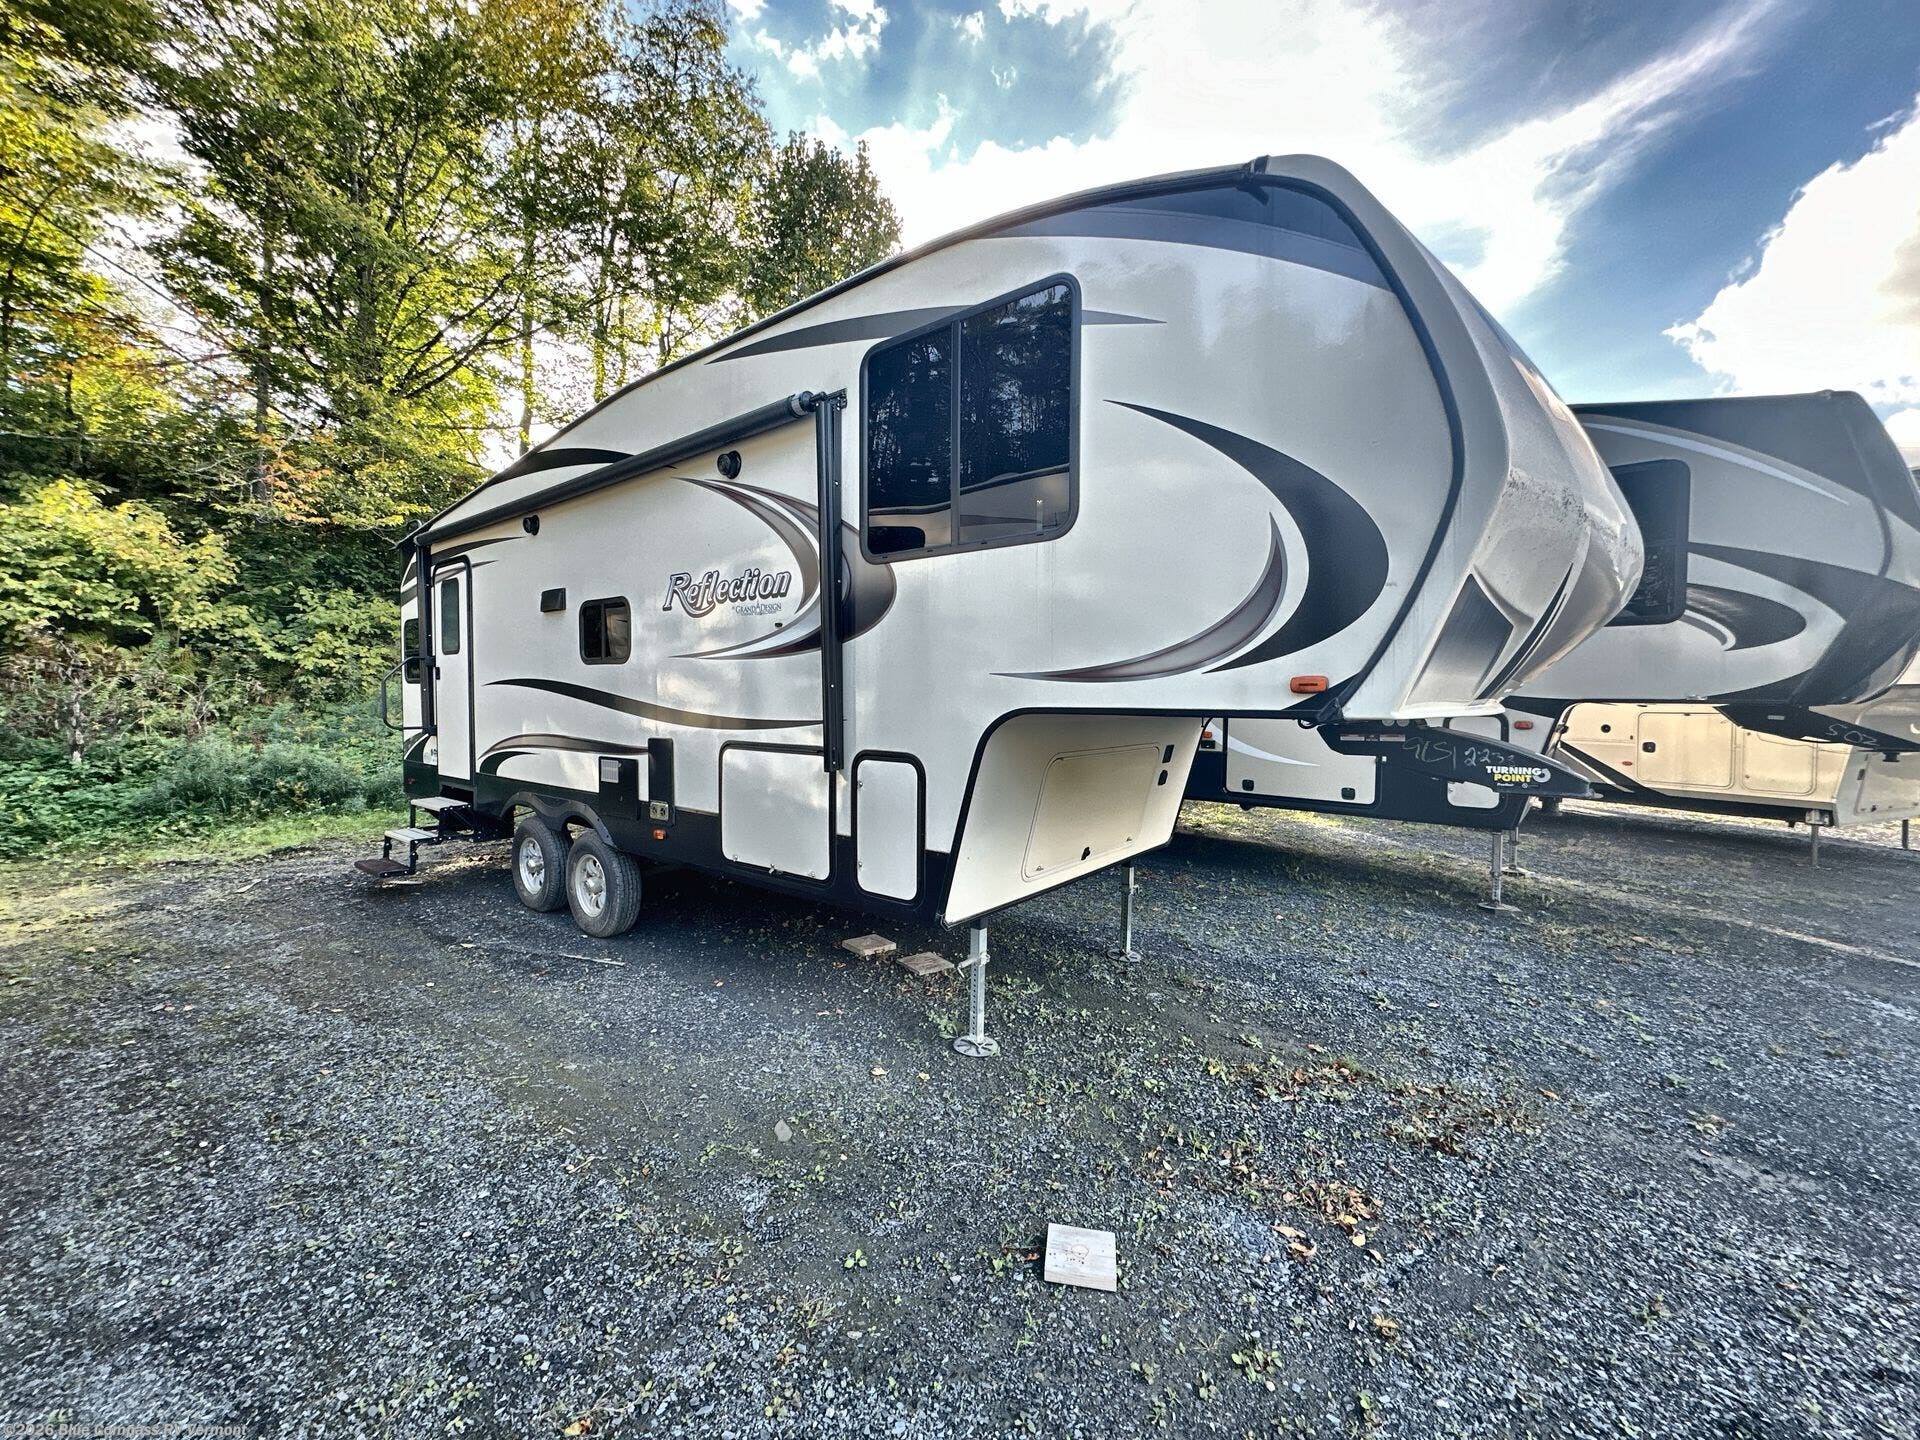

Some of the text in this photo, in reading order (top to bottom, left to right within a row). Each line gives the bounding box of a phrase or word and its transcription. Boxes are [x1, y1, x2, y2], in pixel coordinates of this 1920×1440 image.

[662, 568, 792, 618] Reflection
[735, 605, 757, 614] GRAND
[760, 602, 782, 612] DESIGN
[1485, 765, 1542, 776] TURNING
[1493, 773, 1532, 783] POINT
